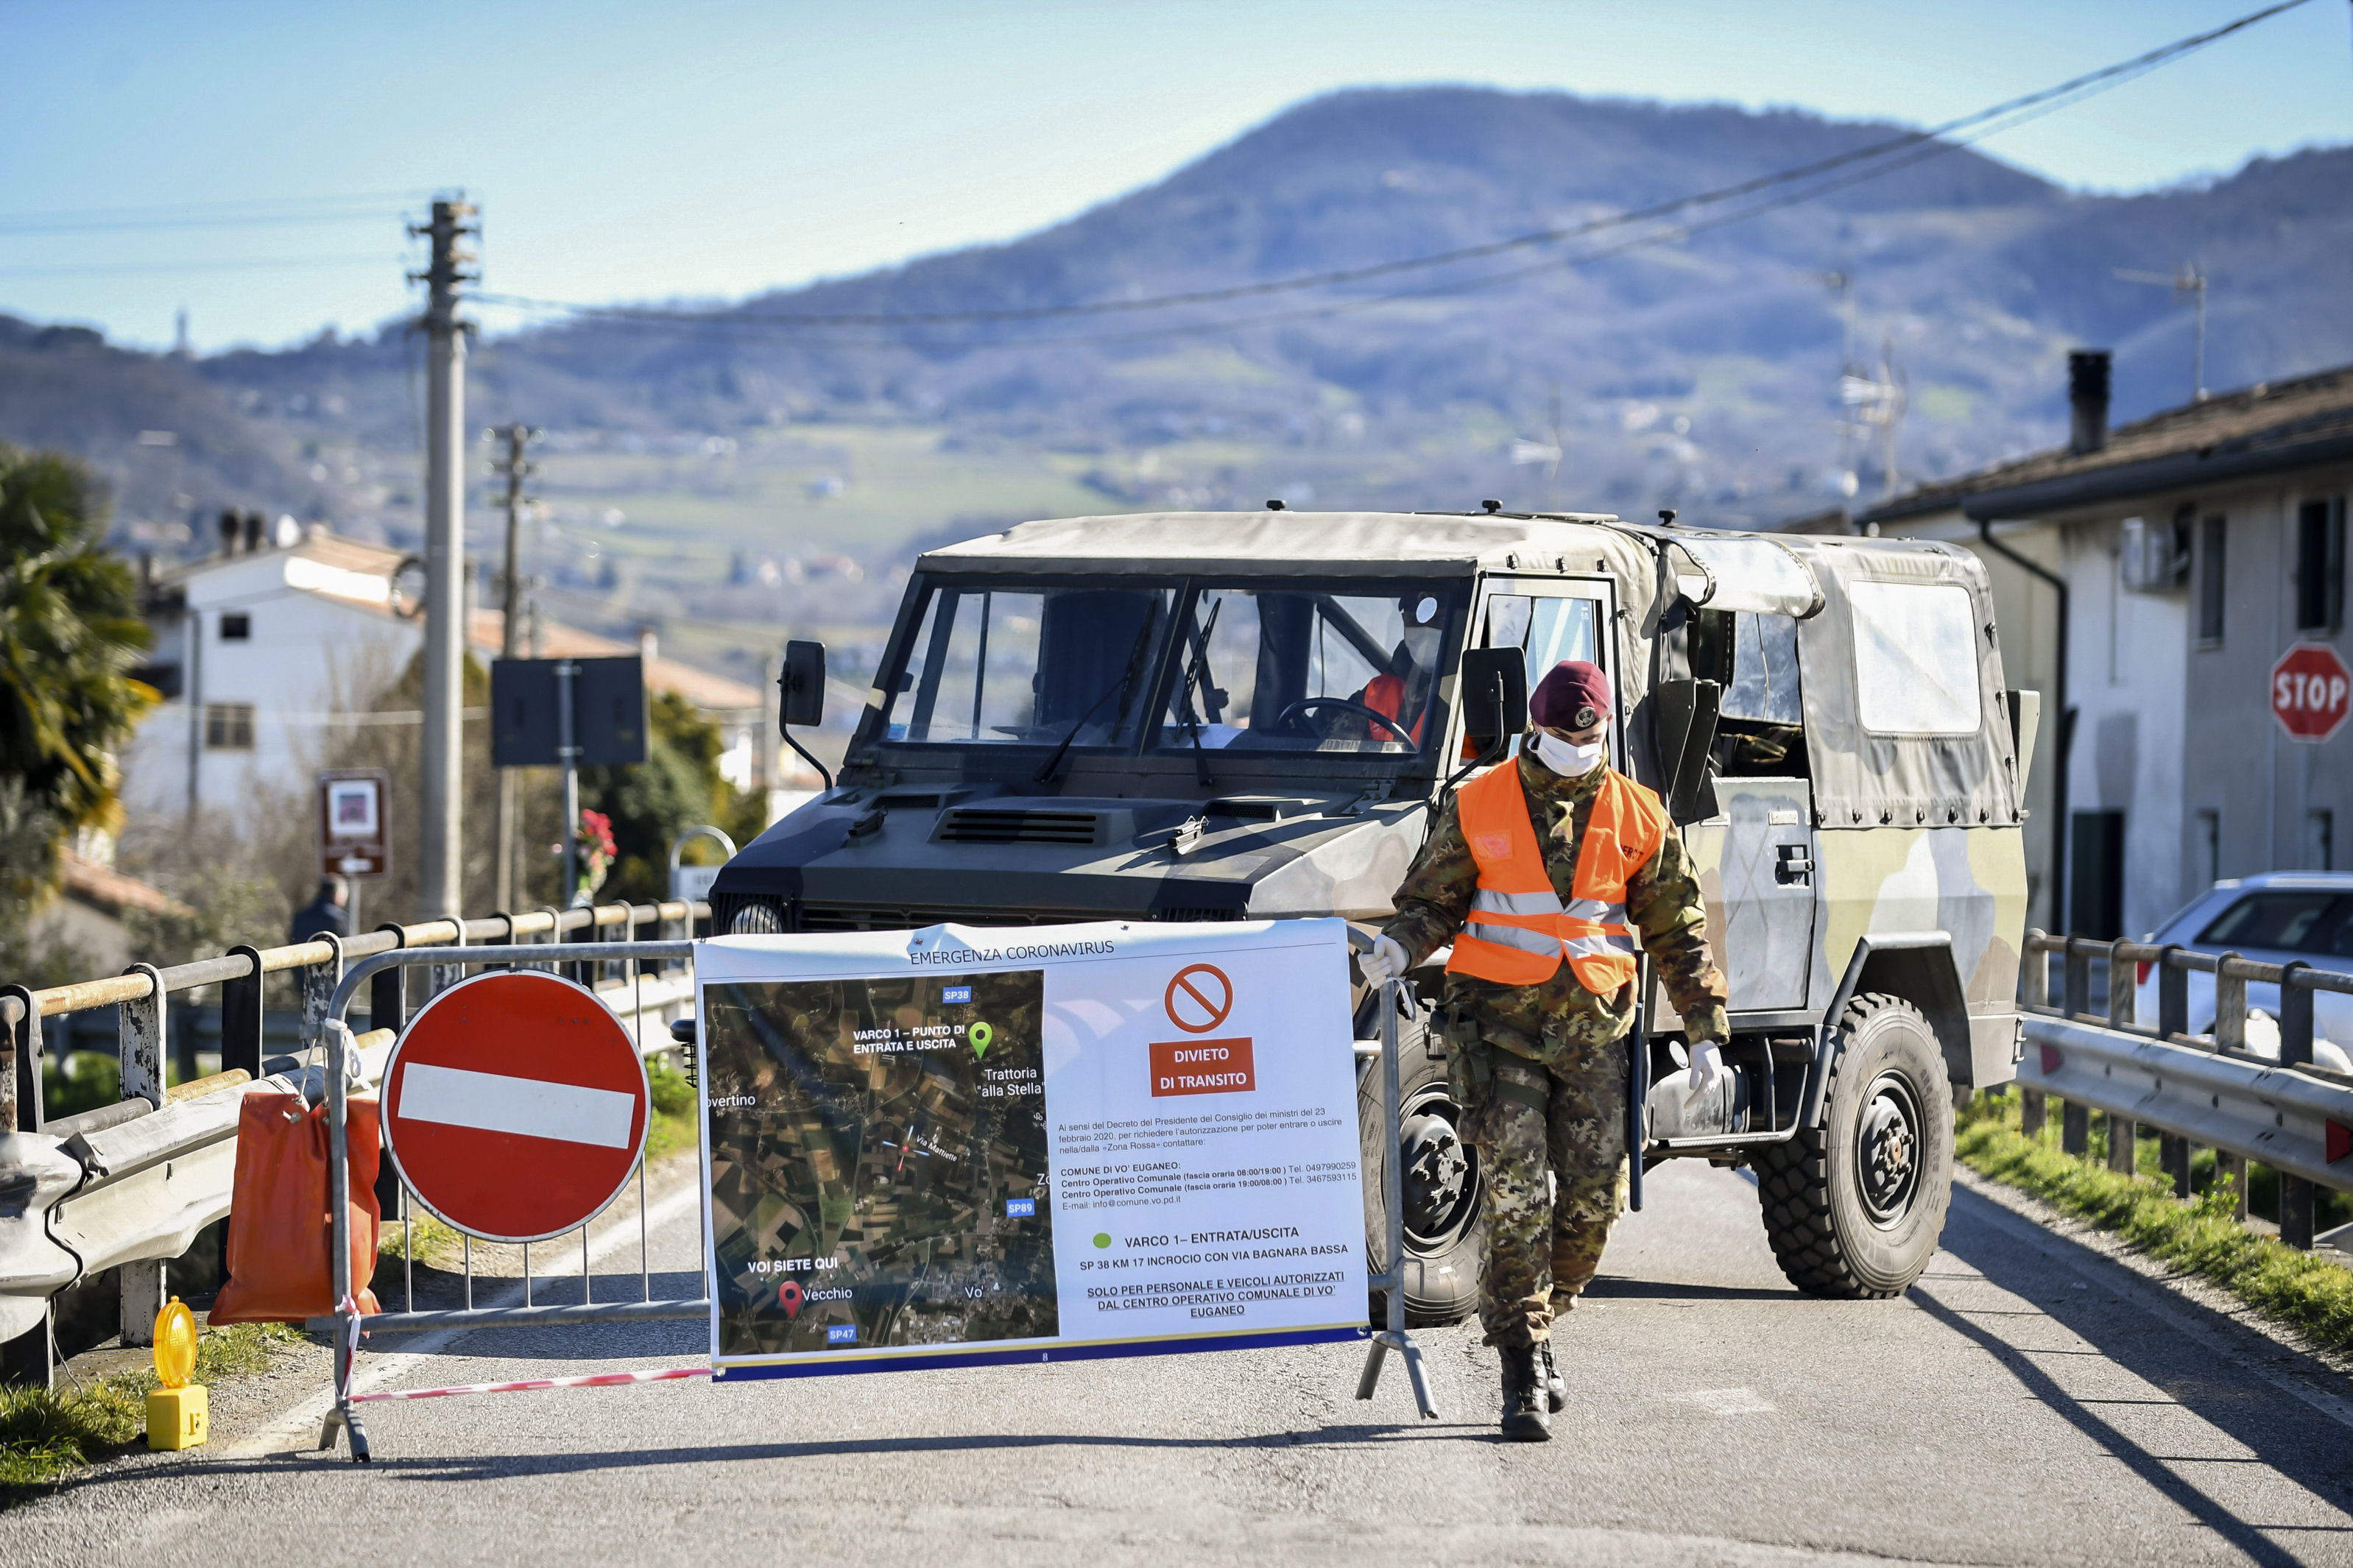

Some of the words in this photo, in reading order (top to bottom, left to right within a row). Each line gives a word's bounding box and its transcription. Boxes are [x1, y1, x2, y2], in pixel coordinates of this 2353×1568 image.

[2276, 672, 2346, 713] STOP
[909, 948, 1002, 965] EMERGENZA
[1006, 940, 1115, 960] CORONAVIRUS
[945, 991, 969, 1000] SP38
[853, 1030, 892, 1040] VARCO
[895, 1028, 900, 1038] 1
[913, 1025, 951, 1036] PUNTO
[954, 1025, 965, 1034] DI
[853, 1042, 904, 1053] ENTRATA
[906, 1041, 914, 1050] E
[917, 1039, 956, 1050] USCITA
[1174, 1048, 1229, 1062] DIVIETO
[984, 1067, 1037, 1081] Trattoria
[1160, 1076, 1174, 1089] DI
[1177, 1072, 1246, 1088] TRANSITO
[1058, 1123, 1066, 1131] Ai
[1068, 1122, 1090, 1131] sensi
[1092, 1121, 1104, 1129] del
[1107, 1120, 1138, 1129] Decreto
[1140, 1118, 1152, 1126] del
[1155, 1116, 1198, 1126] Presidente
[1200, 1115, 1213, 1123] del
[1215, 1112, 1252, 1123] Consiglio
[1255, 1111, 1267, 1119] dei
[1269, 1109, 1298, 1118] ministri
[1300, 1108, 1313, 1116] del
[1315, 1107, 1325, 1115] 23
[917, 1134, 928, 1146] Via
[1059, 1134, 1091, 1143] febbraio
[1118, 1132, 1131, 1141] per
[1134, 1129, 1173, 1138] richiedere
[1175, 1125, 1238, 1135] l'autorizzazione
[1241, 1125, 1254, 1133] per
[1257, 1123, 1277, 1132] poter
[1059, 1144, 1099, 1154] nella/dalla
[1163, 1139, 1205, 1148] contattare:
[1060, 1166, 1101, 1176] COMUNE
[1103, 1165, 1112, 1173] DI
[1132, 1162, 1180, 1172] EUGANEO:
[1061, 1179, 1090, 1187] Centro
[1093, 1176, 1135, 1187] Operativo
[1137, 1173, 1181, 1183] Comunale
[1183, 1171, 1210, 1181] (fascia
[1212, 1170, 1235, 1178] oraria
[1237, 1167, 1280, 1176] 08:00/19:00
[1062, 1190, 1090, 1199] Centro
[1093, 1187, 1135, 1198] Operativo
[1137, 1184, 1182, 1194] Comunale
[1185, 1182, 1210, 1192] (fascia
[1213, 1181, 1235, 1189] oraria
[1238, 1178, 1282, 1187] 19:00/08:00
[1009, 1203, 1032, 1213] SP89
[1062, 1201, 1090, 1210] E-mail:
[1093, 1195, 1181, 1208] info@comune.vo.pd.it
[1124, 1235, 1168, 1248] VARCO
[1191, 1226, 1299, 1243] ENTRATA/USCITA
[747, 1261, 770, 1273] VOI
[774, 1259, 811, 1271] SIETE
[815, 1257, 838, 1269] QUI
[1079, 1261, 1094, 1271] SP
[1097, 1260, 1110, 1269] 38
[1112, 1259, 1129, 1268] KM
[1132, 1257, 1143, 1267] 17
[1147, 1254, 1201, 1266] INCROCIO
[1204, 1251, 1228, 1262] CON
[1231, 1251, 1250, 1260] VIA
[1252, 1246, 1308, 1259] BAGNARA
[1310, 1244, 1348, 1255] BASSA
[964, 1285, 984, 1299] Vo'
[1087, 1286, 1118, 1298] SOLO
[1121, 1285, 1143, 1295] PER
[1146, 1280, 1213, 1293] PERSONALE
[1217, 1279, 1224, 1289] E
[1227, 1276, 1270, 1288] VEICOLI
[1274, 1271, 1344, 1285] AUTORIZZATI
[802, 1287, 853, 1301] Vecchio
[1098, 1300, 1120, 1310] DAL
[1123, 1296, 1168, 1309] CENTRO
[1171, 1292, 1234, 1305] OPERATIVO
[1238, 1288, 1299, 1301] COMUNALE
[1303, 1286, 1314, 1296] DI
[1190, 1304, 1244, 1318] EUGANEO
[830, 1329, 854, 1339] SP47
[1043, 1352, 1048, 1362] 8
